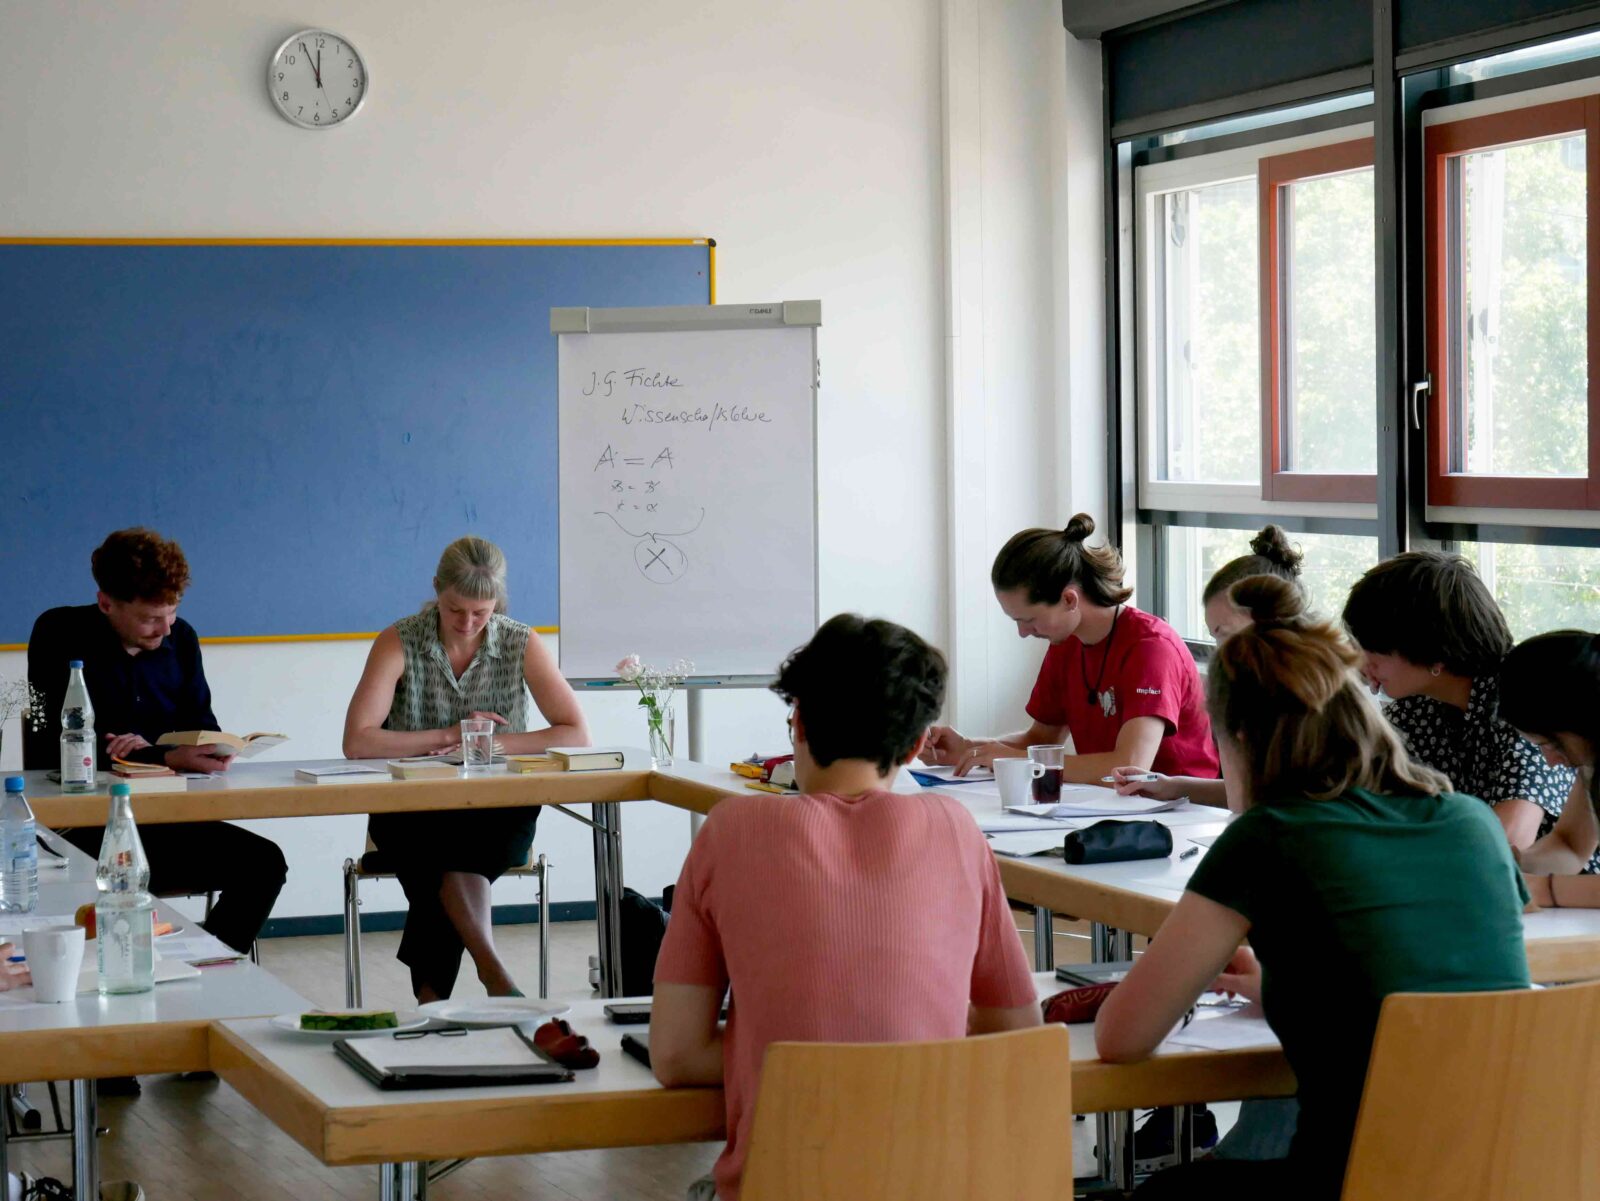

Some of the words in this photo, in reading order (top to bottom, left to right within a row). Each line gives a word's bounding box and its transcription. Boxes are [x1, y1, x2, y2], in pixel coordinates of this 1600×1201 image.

[315, 38, 325, 48] 12
[285, 55, 296, 65] 10
[347, 59, 354, 68] 2
[278, 72, 285, 81] 9
[352, 78, 359, 88] 3
[282, 91, 289, 101] 8
[345, 97, 352, 106] 4
[298, 106, 304, 115] 7
[331, 109, 338, 118] 5
[313, 112, 320, 121] 6
[623, 368, 684, 387] Fichte
[651, 446, 675, 470] A
